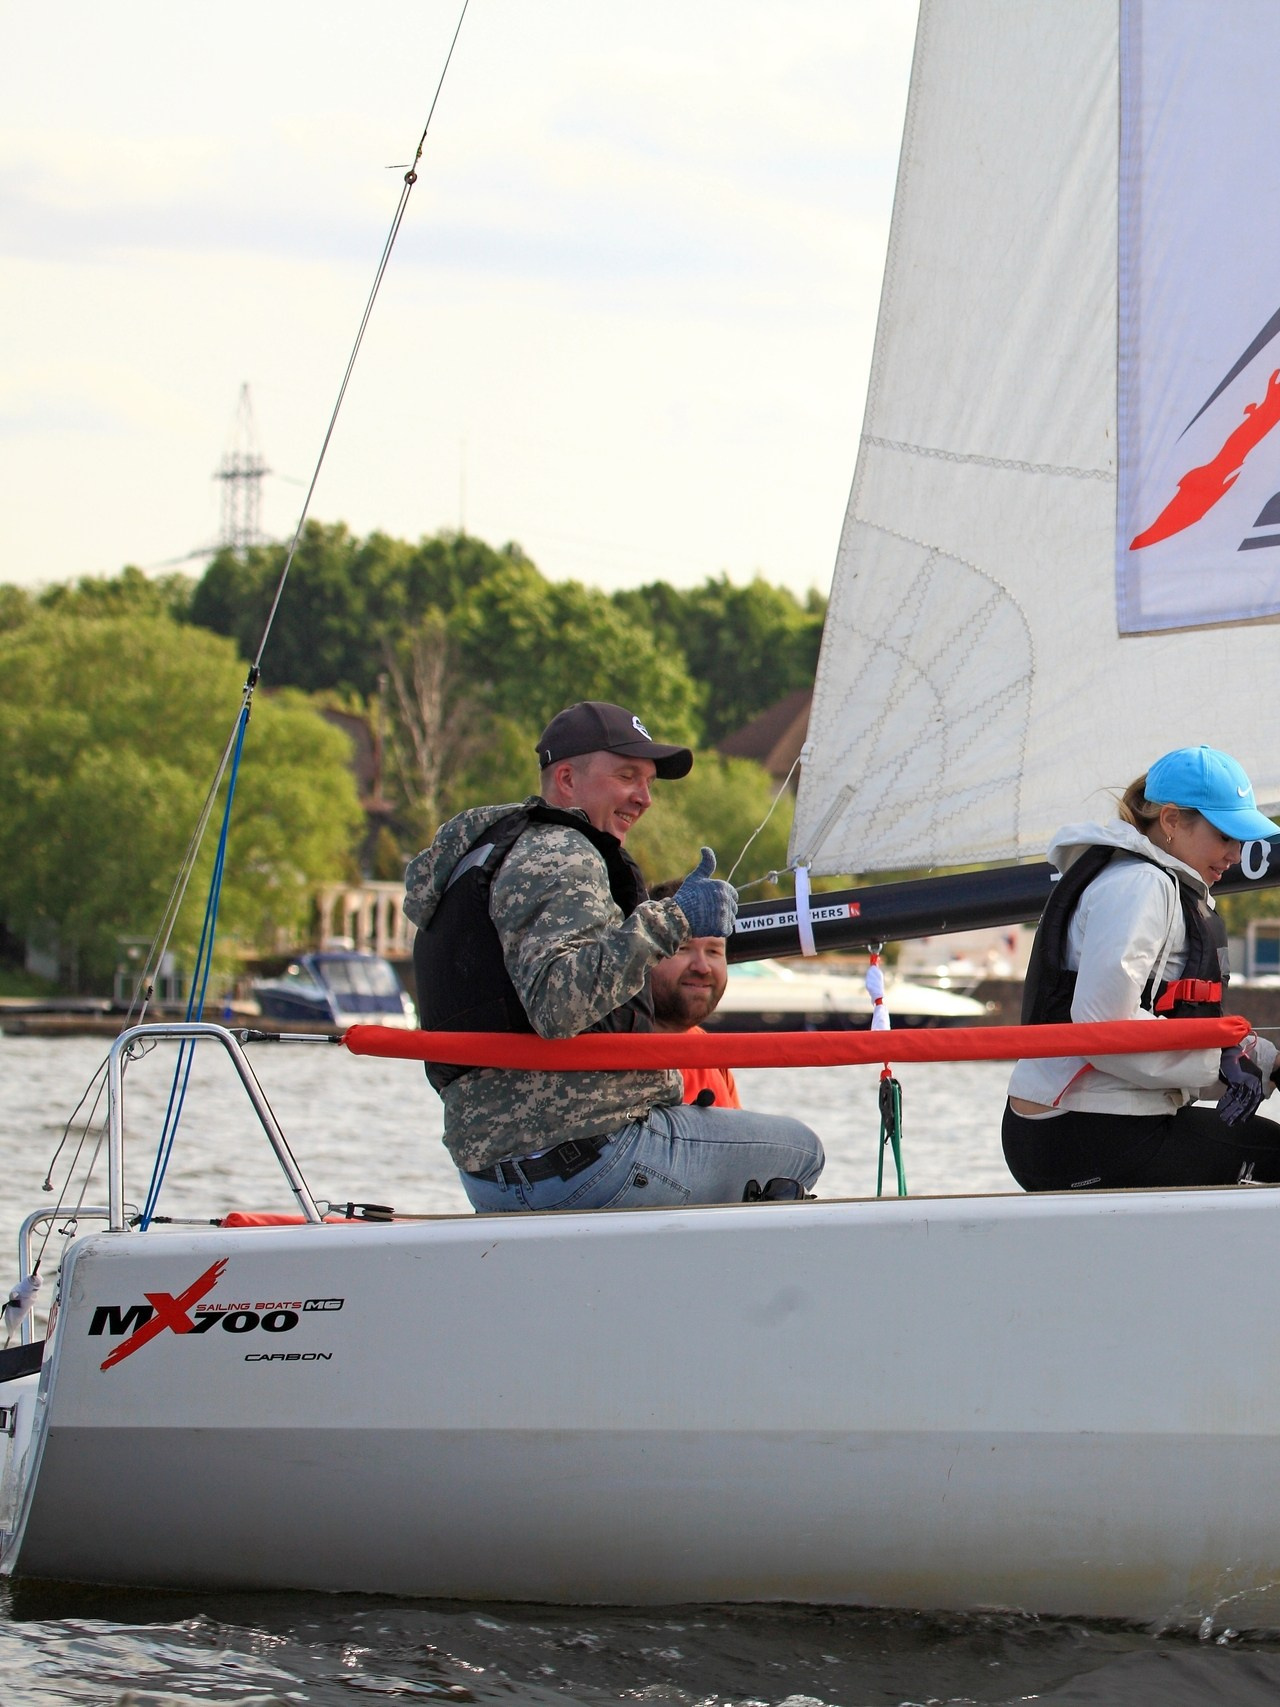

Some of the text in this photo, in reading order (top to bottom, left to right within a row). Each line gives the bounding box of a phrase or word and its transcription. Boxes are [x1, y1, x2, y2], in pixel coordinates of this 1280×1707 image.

[741, 907, 843, 930] WIND BRHERS
[196, 1302, 251, 1312] SAILING
[254, 1301, 302, 1310] BOATS
[244, 1353, 333, 1362] CARBON
